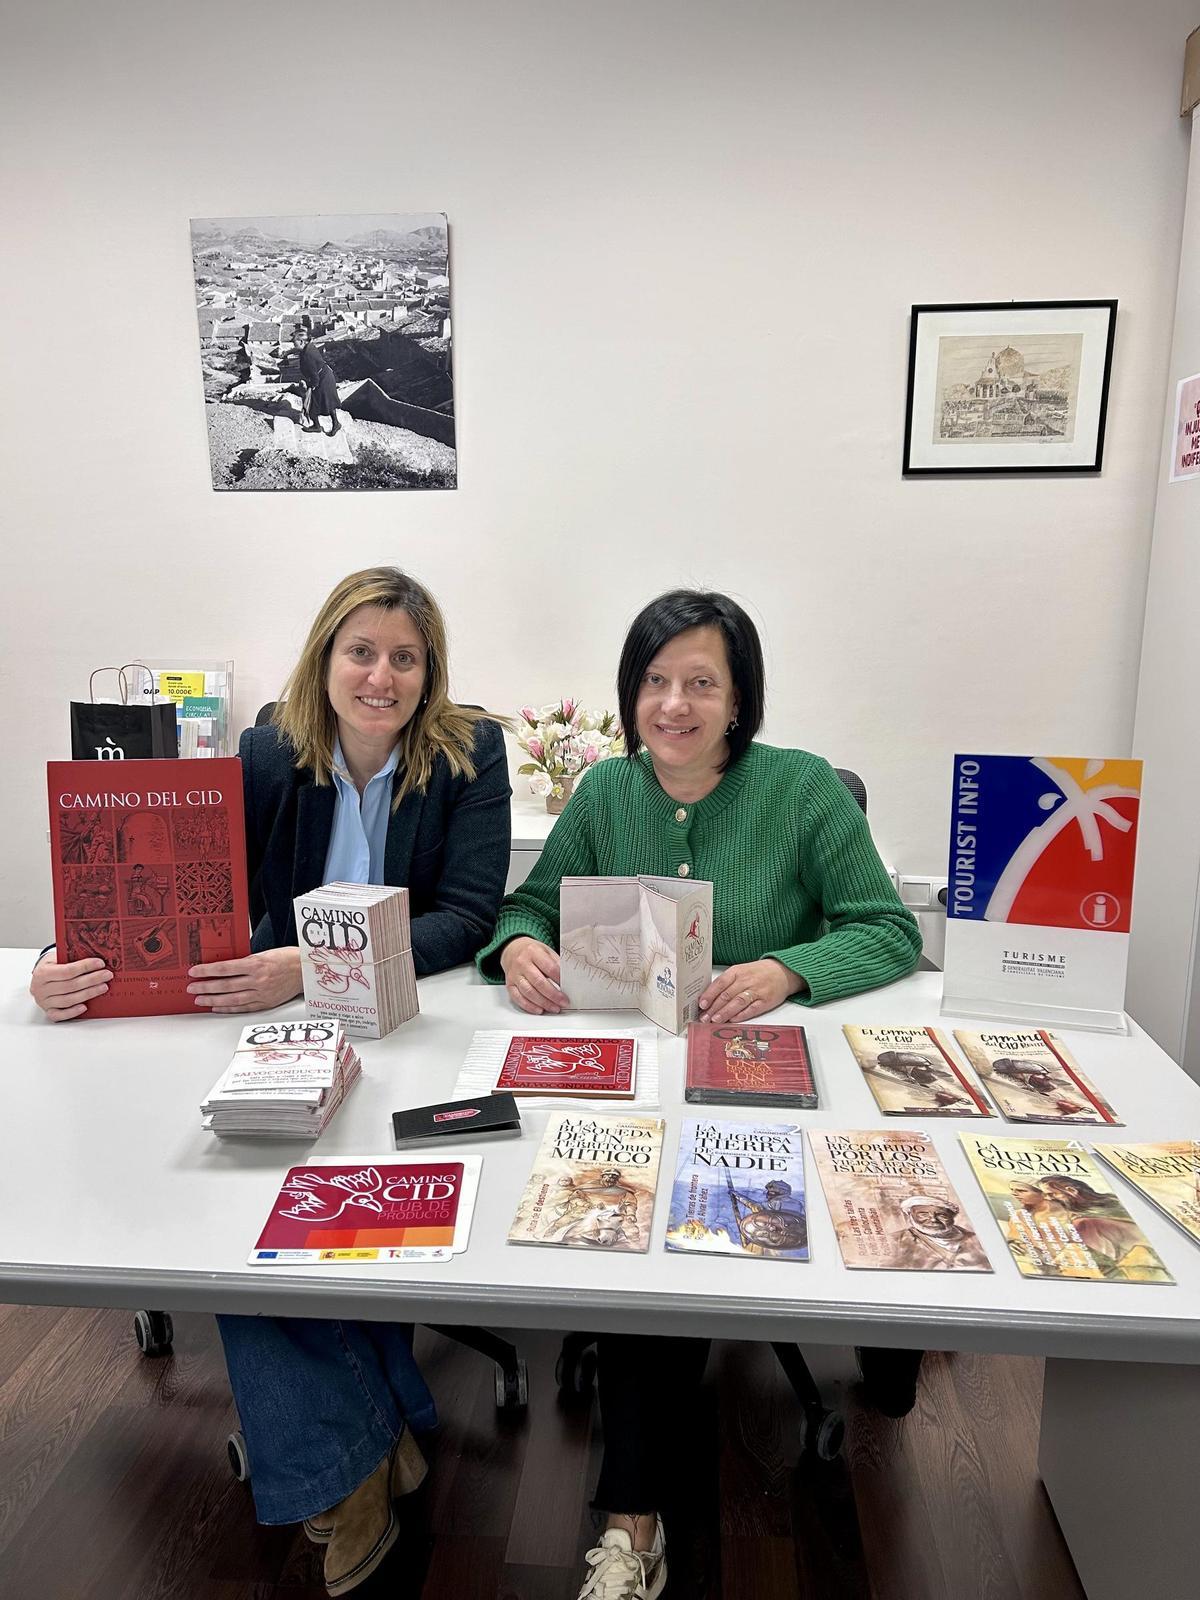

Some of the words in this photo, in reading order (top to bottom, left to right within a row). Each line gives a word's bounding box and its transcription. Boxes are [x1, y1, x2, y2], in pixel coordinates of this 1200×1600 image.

[958, 759, 980, 816] INFO
[59, 792, 141, 809] CAMINO
[147, 791, 181, 807] DEL
[186, 790, 223, 806] CID
[954, 821, 977, 915] TOURIST
[301, 907, 365, 925] CAMINO
[302, 918, 368, 952] CID
[1003, 951, 1066, 963] TURISME
[309, 1000, 376, 1014] SALVOCONDUCTO
[252, 1022, 334, 1033] CAMINO
[246, 1028, 333, 1045] CID
[712, 1028, 780, 1041] CID
[999, 1042, 1018, 1050] CID
[234, 1068, 331, 1077] SALVOCONDUCTO
[577, 1120, 597, 1128] LA
[697, 1124, 716, 1132] LA
[557, 1131, 586, 1141] DE
[593, 1133, 623, 1144] UN
[695, 1131, 792, 1144] PELIGROSA
[554, 1140, 652, 1152] TERRITORIO
[696, 1138, 791, 1153] TIERRA
[827, 1143, 925, 1152] RECORRIDO
[976, 1141, 998, 1150] LA
[693, 1153, 788, 1171] NADIE
[829, 1151, 872, 1160] POR
[878, 1152, 922, 1161] LOS
[978, 1149, 1080, 1163] CIUDAD
[386, 1174, 456, 1184] CAMINO
[383, 1183, 455, 1201] CID
[381, 1202, 423, 1212] CLUB
[428, 1201, 450, 1211] DE
[377, 1210, 450, 1221] PRODUCTO
